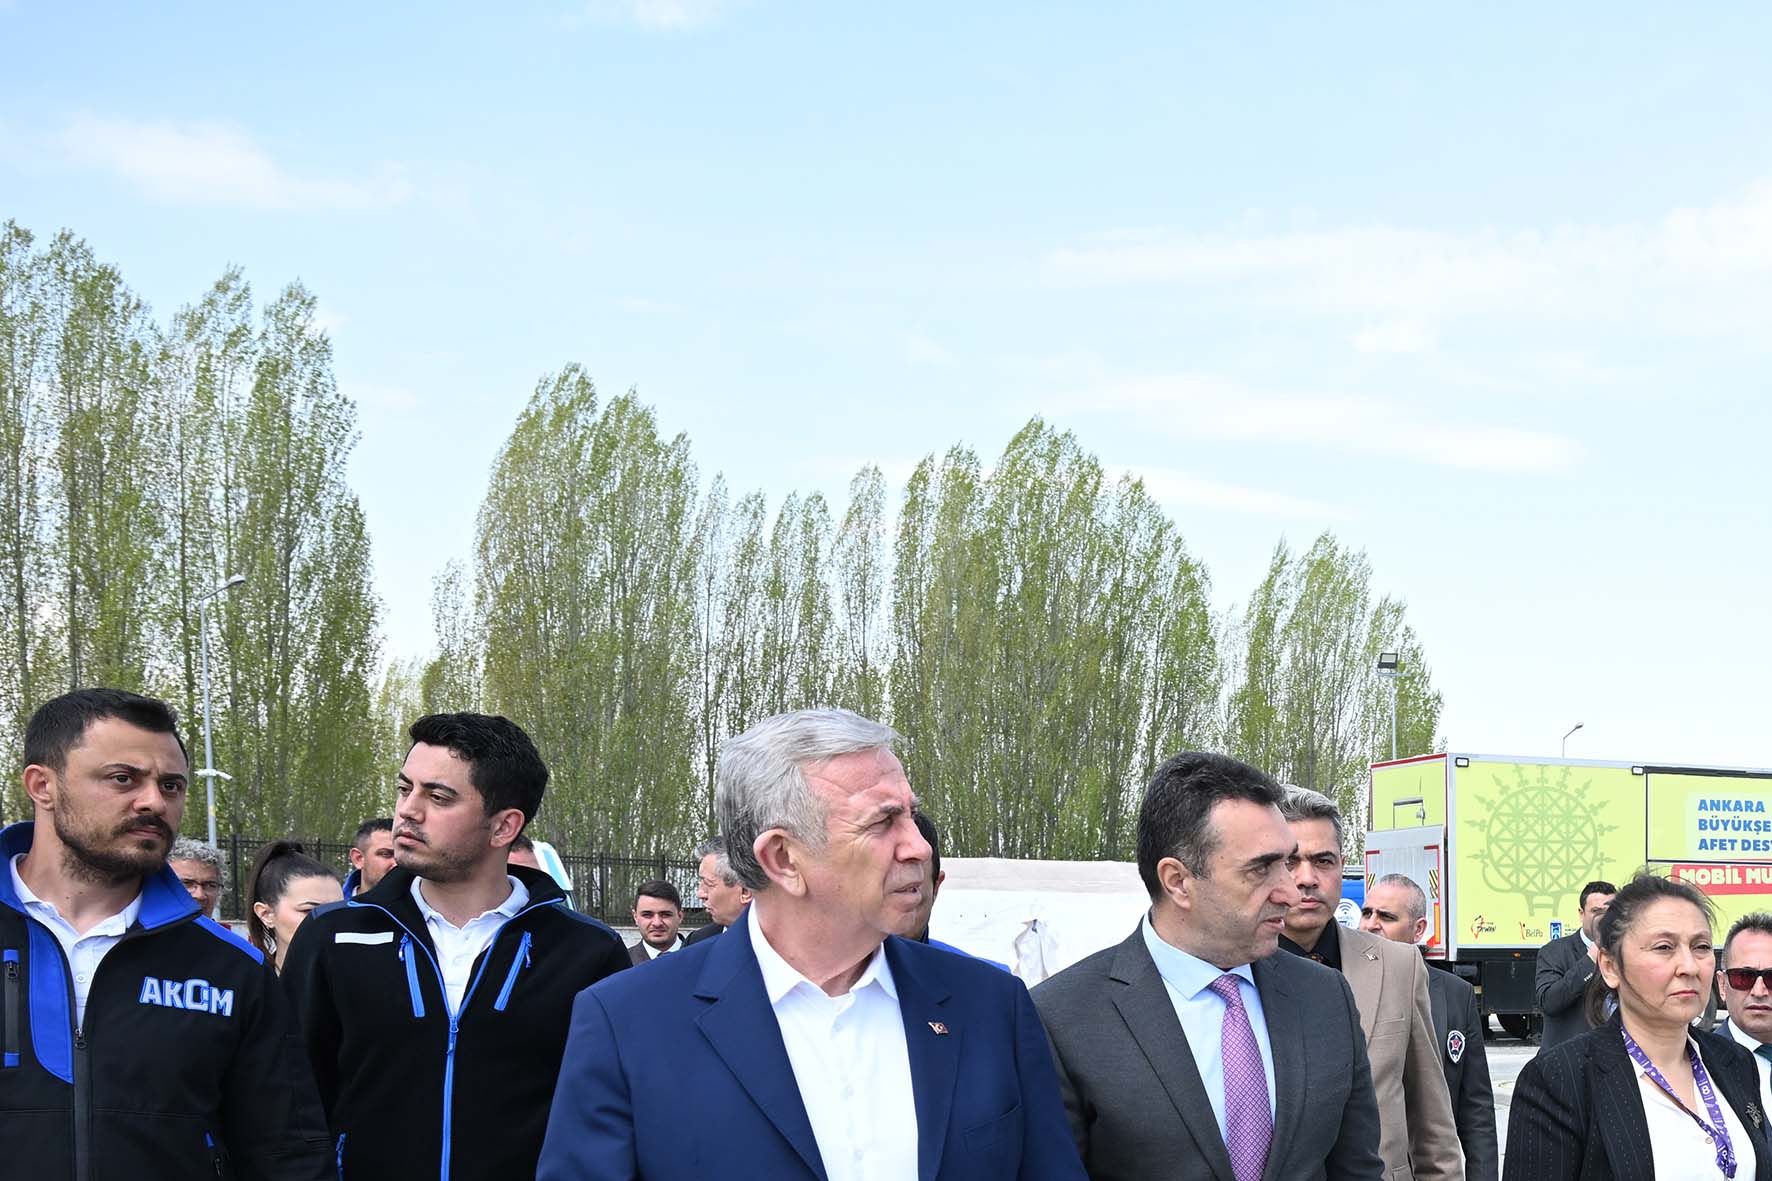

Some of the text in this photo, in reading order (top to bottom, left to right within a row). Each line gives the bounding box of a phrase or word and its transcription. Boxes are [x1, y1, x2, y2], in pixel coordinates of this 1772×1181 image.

[1698, 799, 1765, 813] ANKARA
[1698, 838, 1738, 850] AFET
[1679, 864, 1742, 885] MOBİL
